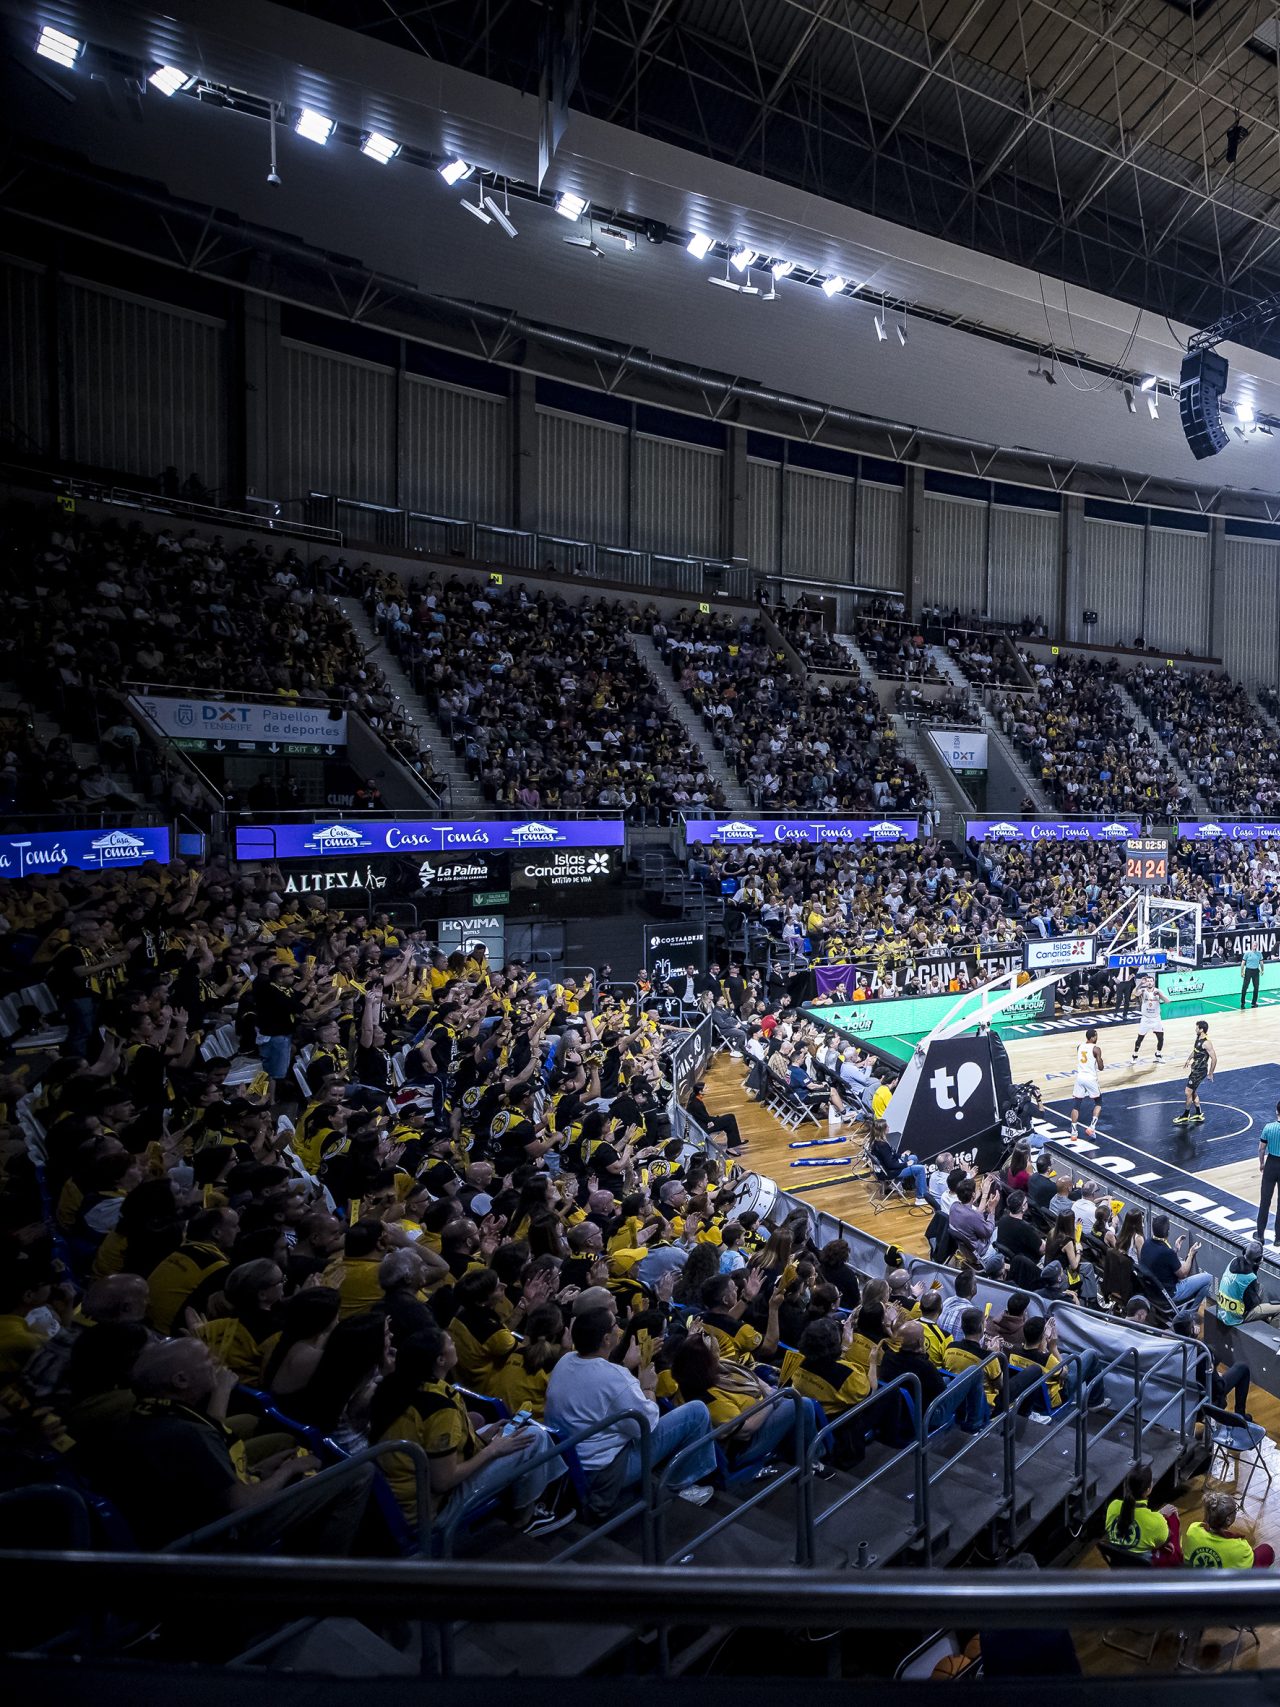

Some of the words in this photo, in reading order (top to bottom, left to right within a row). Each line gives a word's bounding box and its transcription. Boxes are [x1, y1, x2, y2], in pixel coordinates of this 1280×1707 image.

[202, 705, 251, 722] DXT
[263, 709, 319, 723] Pabellón
[203, 721, 253, 732] TENERIFE
[263, 723, 280, 733] de
[283, 723, 340, 737] deportes
[288, 745, 308, 753] EXIT
[953, 751, 975, 760] DXT
[385, 828, 431, 849] Casa
[432, 826, 489, 850] Tomás
[774, 824, 810, 841] Casa
[810, 824, 853, 842] Tomás
[1031, 825, 1057, 839] Casa
[1057, 825, 1090, 838] Tomás
[1233, 826, 1254, 838] Casa
[1254, 826, 1280, 837] Tomás
[1145, 840, 1166, 849] 02:58
[10, 841, 68, 878] Tomás
[555, 854, 585, 866] Islas
[437, 867, 451, 877] La
[453, 865, 488, 876] Palma
[525, 864, 585, 877] Canarias
[1127, 858, 1142, 878] 24
[1145, 859, 1165, 879] 24
[442, 918, 499, 931] HOVIMA
[1053, 943, 1071, 951] Islas
[1036, 950, 1071, 959] Canarias
[1118, 955, 1157, 965] HOVIMA
[1025, 1001, 1045, 1010] FOUR
